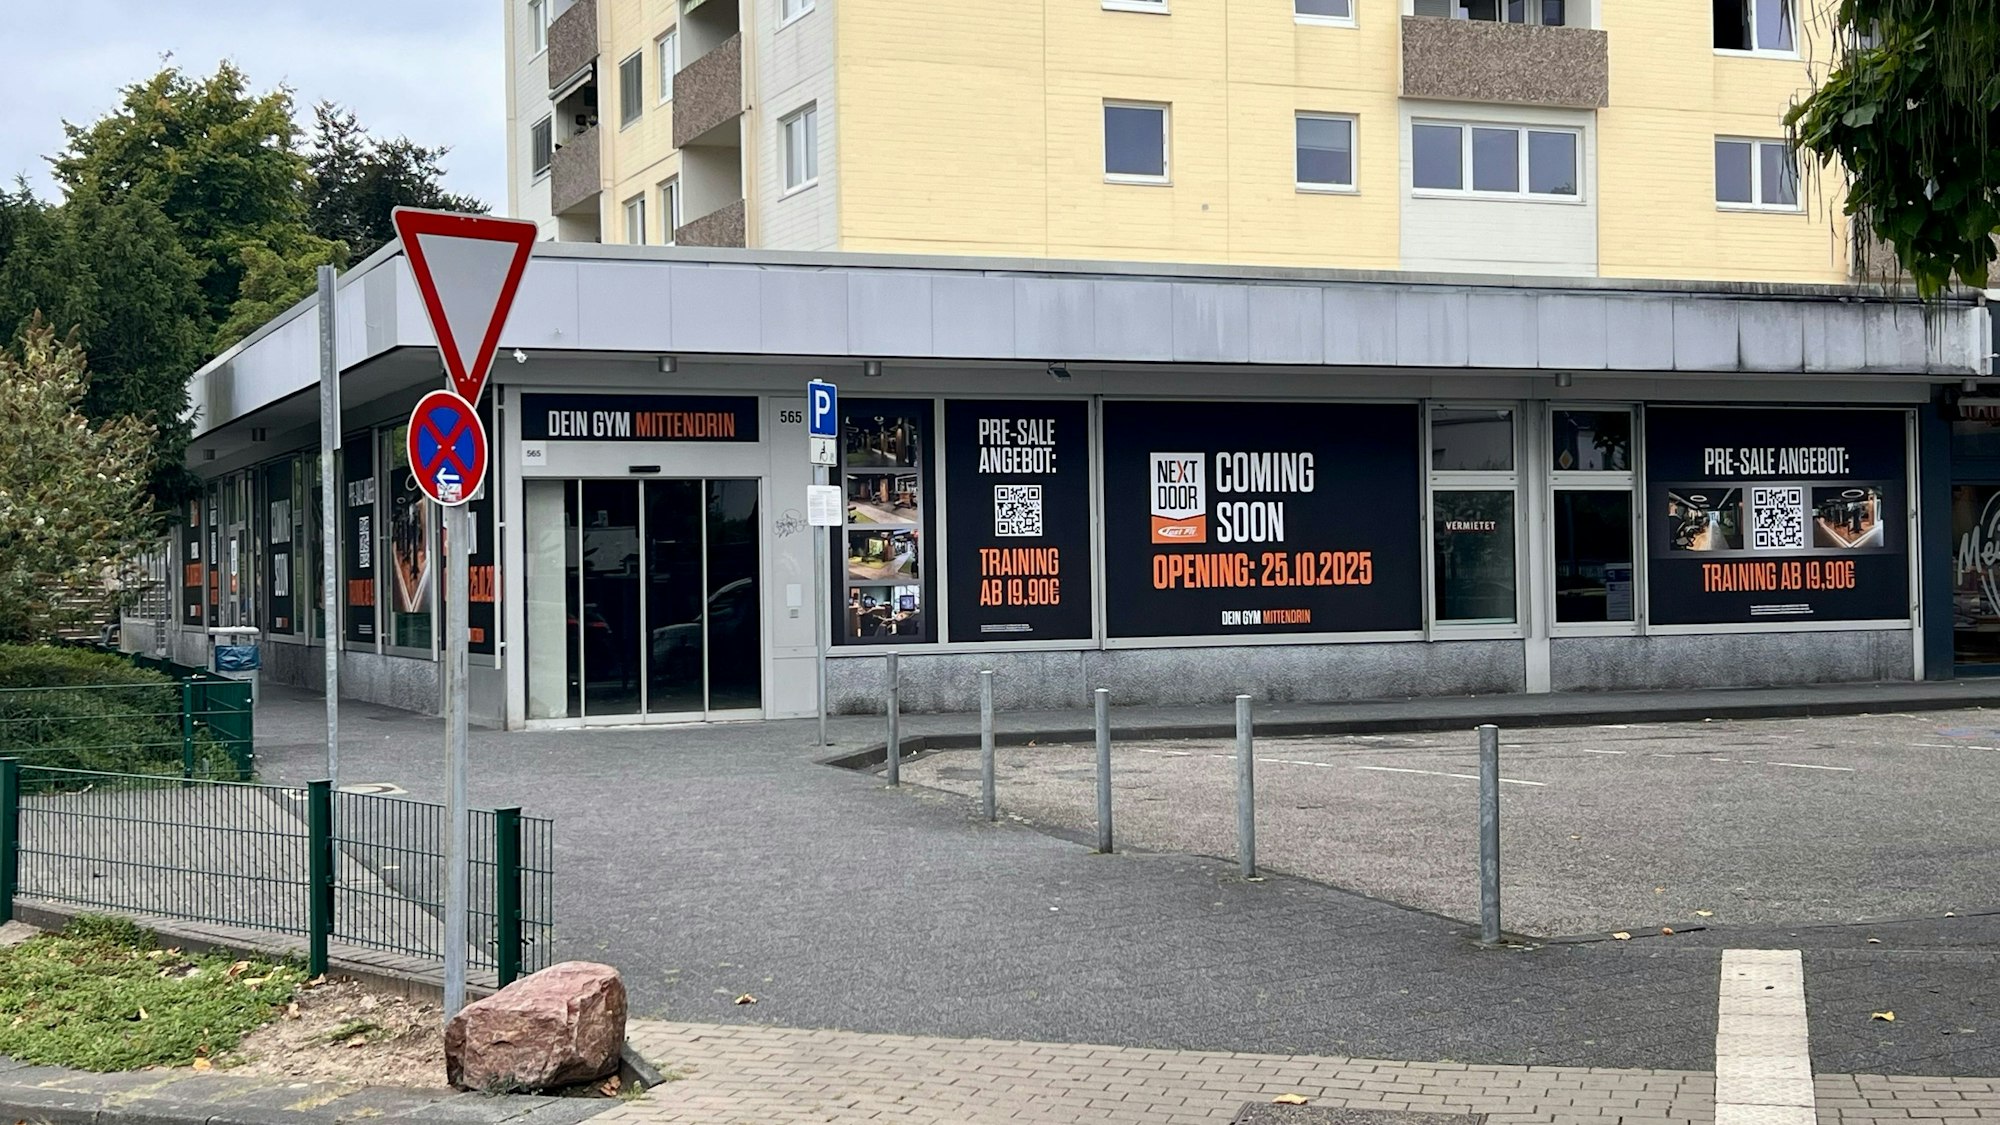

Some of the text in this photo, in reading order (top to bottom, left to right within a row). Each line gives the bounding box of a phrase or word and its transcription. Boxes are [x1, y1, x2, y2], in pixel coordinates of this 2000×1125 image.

[780, 410, 803, 424] 565
[814, 389, 831, 429] P
[548, 410, 735, 438] DEIN GYM MITTENDRIN
[978, 418, 1056, 446] PRE-SALE
[526, 449, 542, 458] 565
[978, 446, 1057, 474] ANGEBOT:
[1704, 447, 1850, 475] PRE-SALE ANGEBOT:
[1157, 460, 1198, 484] NEXT
[1215, 451, 1315, 494] COMING
[1157, 485, 1198, 510] DOOR
[1215, 501, 1285, 544] SOON
[1445, 520, 1496, 531] VERMIETET
[979, 548, 1060, 577] TRAINING
[1152, 551, 1373, 590] OPENING: 25.10.2025
[1702, 560, 1856, 592] TRAINING AB 19,90€
[980, 577, 1060, 607] AB 19,90€
[1221, 609, 1311, 626] DEIN GYM MITTENDRIN
